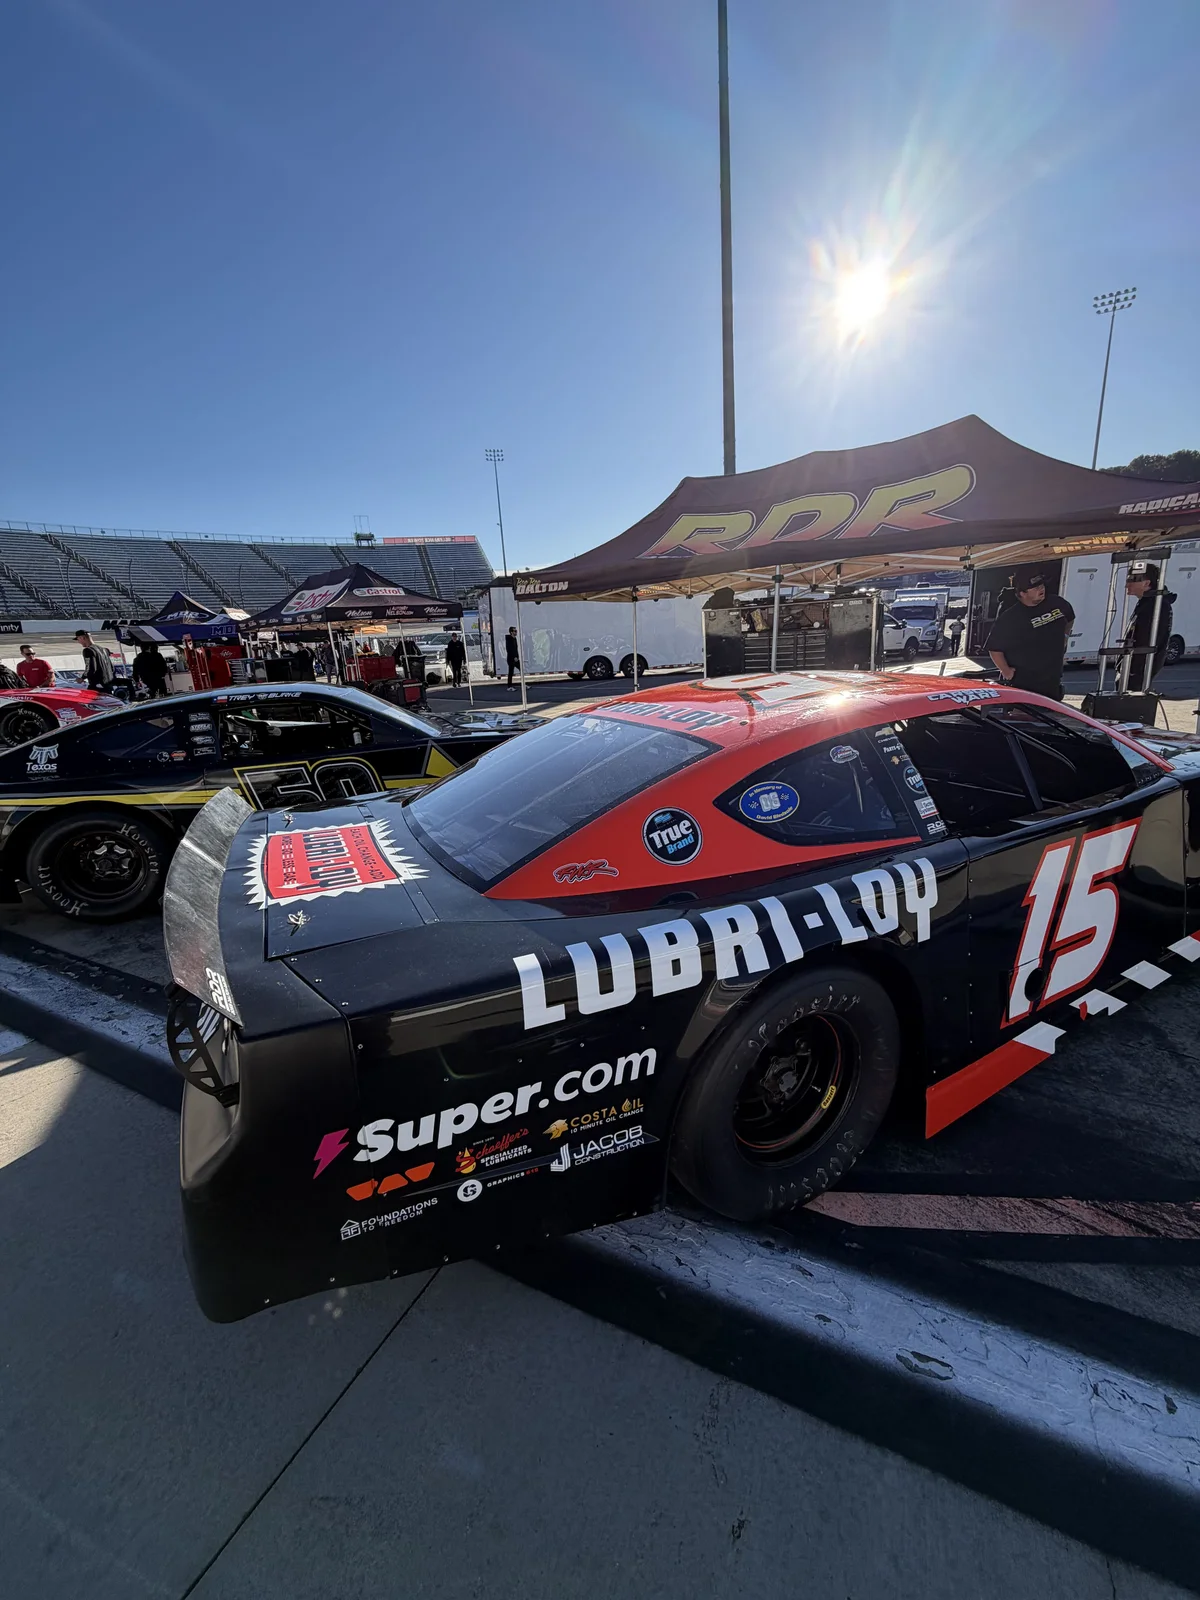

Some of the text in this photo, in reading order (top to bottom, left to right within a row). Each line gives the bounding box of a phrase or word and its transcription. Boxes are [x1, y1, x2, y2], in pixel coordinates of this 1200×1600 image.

[636, 463, 977, 560] RDR
[1119, 493, 1200, 515] RADICA
[366, 588, 401, 596] Castrol
[515, 581, 569, 595] DALTON
[951, 692, 1001, 706] WARE
[26, 762, 57, 771] Texas
[649, 819, 693, 849] True
[666, 833, 695, 855] Brand
[116, 823, 160, 874] Hoosier
[296, 829, 363, 891] LUBRI-LOY
[358, 846, 377, 866] CHANGE
[369, 868, 386, 880] ADD
[38, 866, 89, 915] Hoosier
[1001, 816, 1142, 1029] 15
[513, 857, 938, 1030] LUBRI-LOY
[353, 1047, 657, 1163] Super.com
[570, 1106, 618, 1128] COSTA
[579, 1120, 604, 1131] MINUTE
[618, 1107, 644, 1119] CHANGE
[480, 1145, 528, 1164] SPECIALIZED
[573, 1125, 643, 1160] JACOB
[574, 1137, 645, 1166] CONSTRUCTION
[485, 1148, 532, 1167] LUBRICANTS
[487, 1171, 525, 1187] GRAPHICS
[361, 1197, 438, 1228] FOUNDATIONS
[363, 1209, 423, 1233] TO FREEDOM
